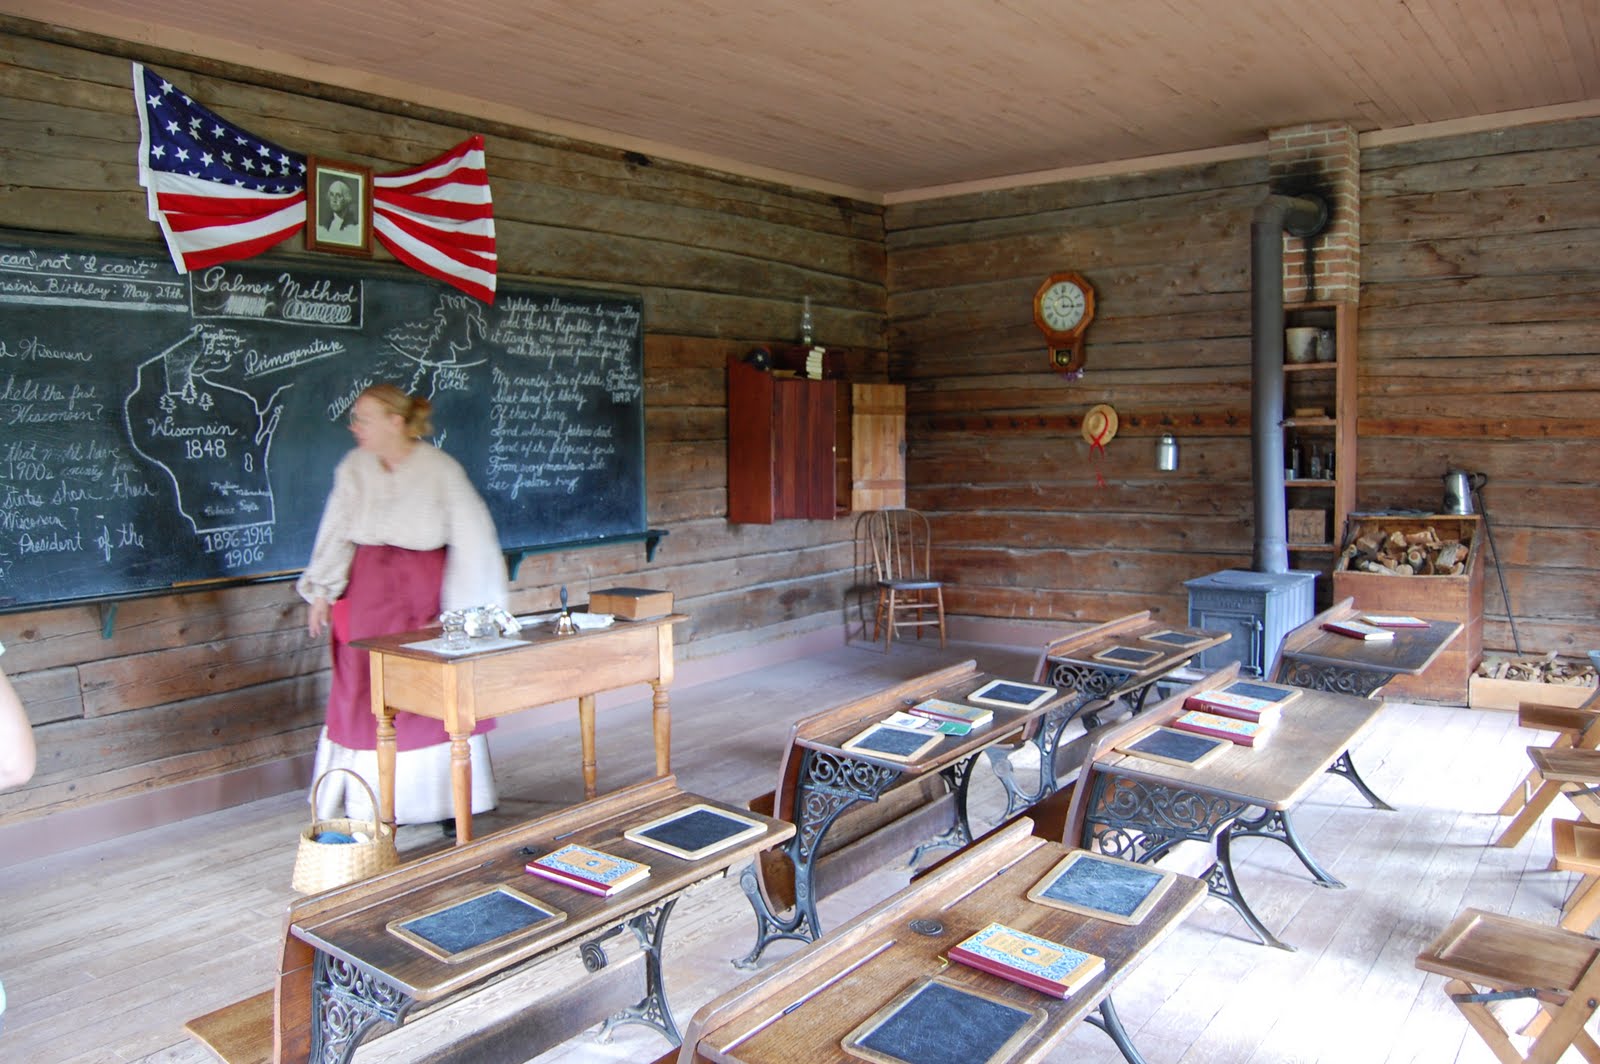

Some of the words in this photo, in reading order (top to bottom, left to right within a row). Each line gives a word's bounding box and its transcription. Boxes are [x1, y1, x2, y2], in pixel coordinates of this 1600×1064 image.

[39, 254, 72, 270] not
[122, 283, 152, 301] May
[195, 266, 275, 293] Palmer
[278, 273, 358, 303] Method
[542, 298, 592, 318] allegiance
[596, 304, 605, 317] to
[500, 314, 520, 329] and
[535, 316, 552, 331] the
[553, 317, 594, 334] Republic
[490, 330, 500, 344] it
[556, 333, 586, 346] nation
[245, 339, 344, 376] Primogeniture
[528, 343, 556, 369] liberty
[556, 346, 573, 357] and
[1, 375, 39, 401] held
[40, 384, 65, 401] the
[491, 366, 510, 394] My
[569, 371, 581, 393] of
[328, 377, 373, 422] Atlantic
[518, 388, 542, 402] land
[147, 416, 238, 437] Wisconsin
[490, 404, 508, 428] Of
[4, 441, 37, 463] that
[185, 438, 227, 459] 1848
[489, 437, 519, 454] Land
[521, 440, 532, 458] of
[532, 440, 548, 454] the
[486, 456, 519, 475] From
[51, 479, 102, 505] share
[510, 473, 552, 500] freedom
[16, 531, 83, 555] President
[94, 525, 113, 562] of
[116, 522, 144, 549] the
[225, 545, 264, 568] 1906
